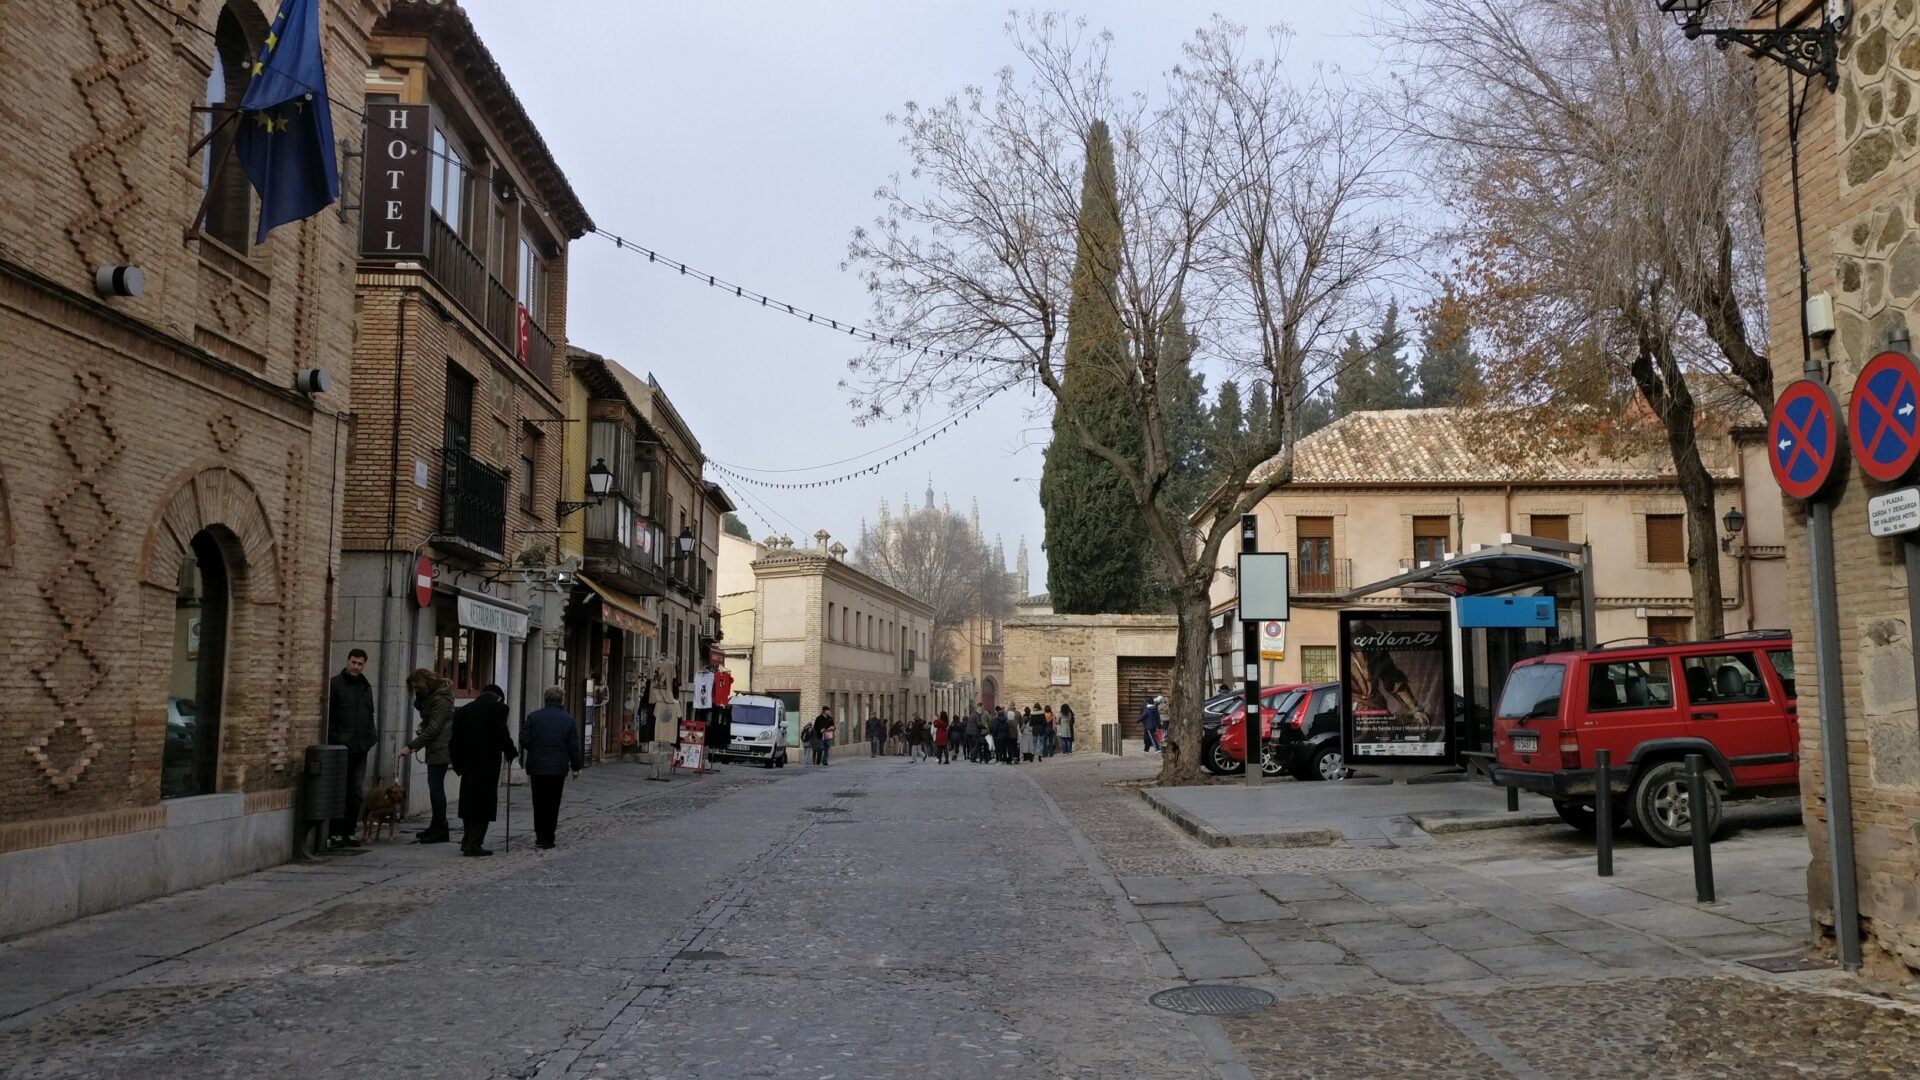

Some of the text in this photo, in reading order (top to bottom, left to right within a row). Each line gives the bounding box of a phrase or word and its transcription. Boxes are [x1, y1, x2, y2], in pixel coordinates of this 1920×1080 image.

[384, 109, 409, 250] HOTEL
[1881, 515, 1902, 524] VIAJEROS
[1902, 511, 1917, 519] HOTEL
[1893, 502, 1917, 512] DESCARGA
[470, 602, 499, 631] RESTAURANTE
